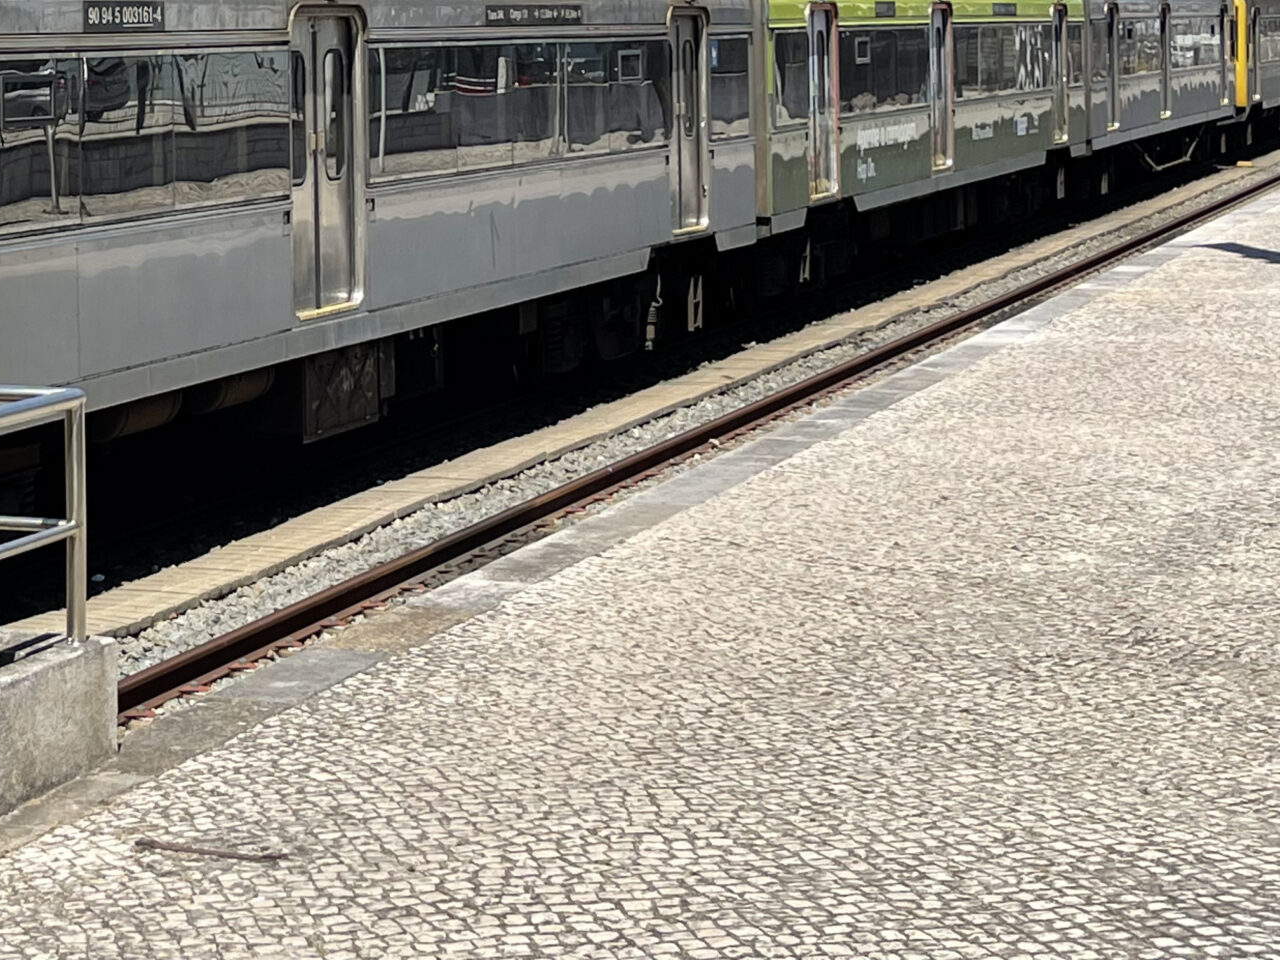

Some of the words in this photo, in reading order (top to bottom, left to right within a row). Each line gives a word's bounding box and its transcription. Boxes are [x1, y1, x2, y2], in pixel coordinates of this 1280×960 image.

[88, 6, 100, 25] 90
[102, 6, 113, 25] 94
[115, 6, 121, 24] 5
[122, 5, 162, 25] 003161-4
